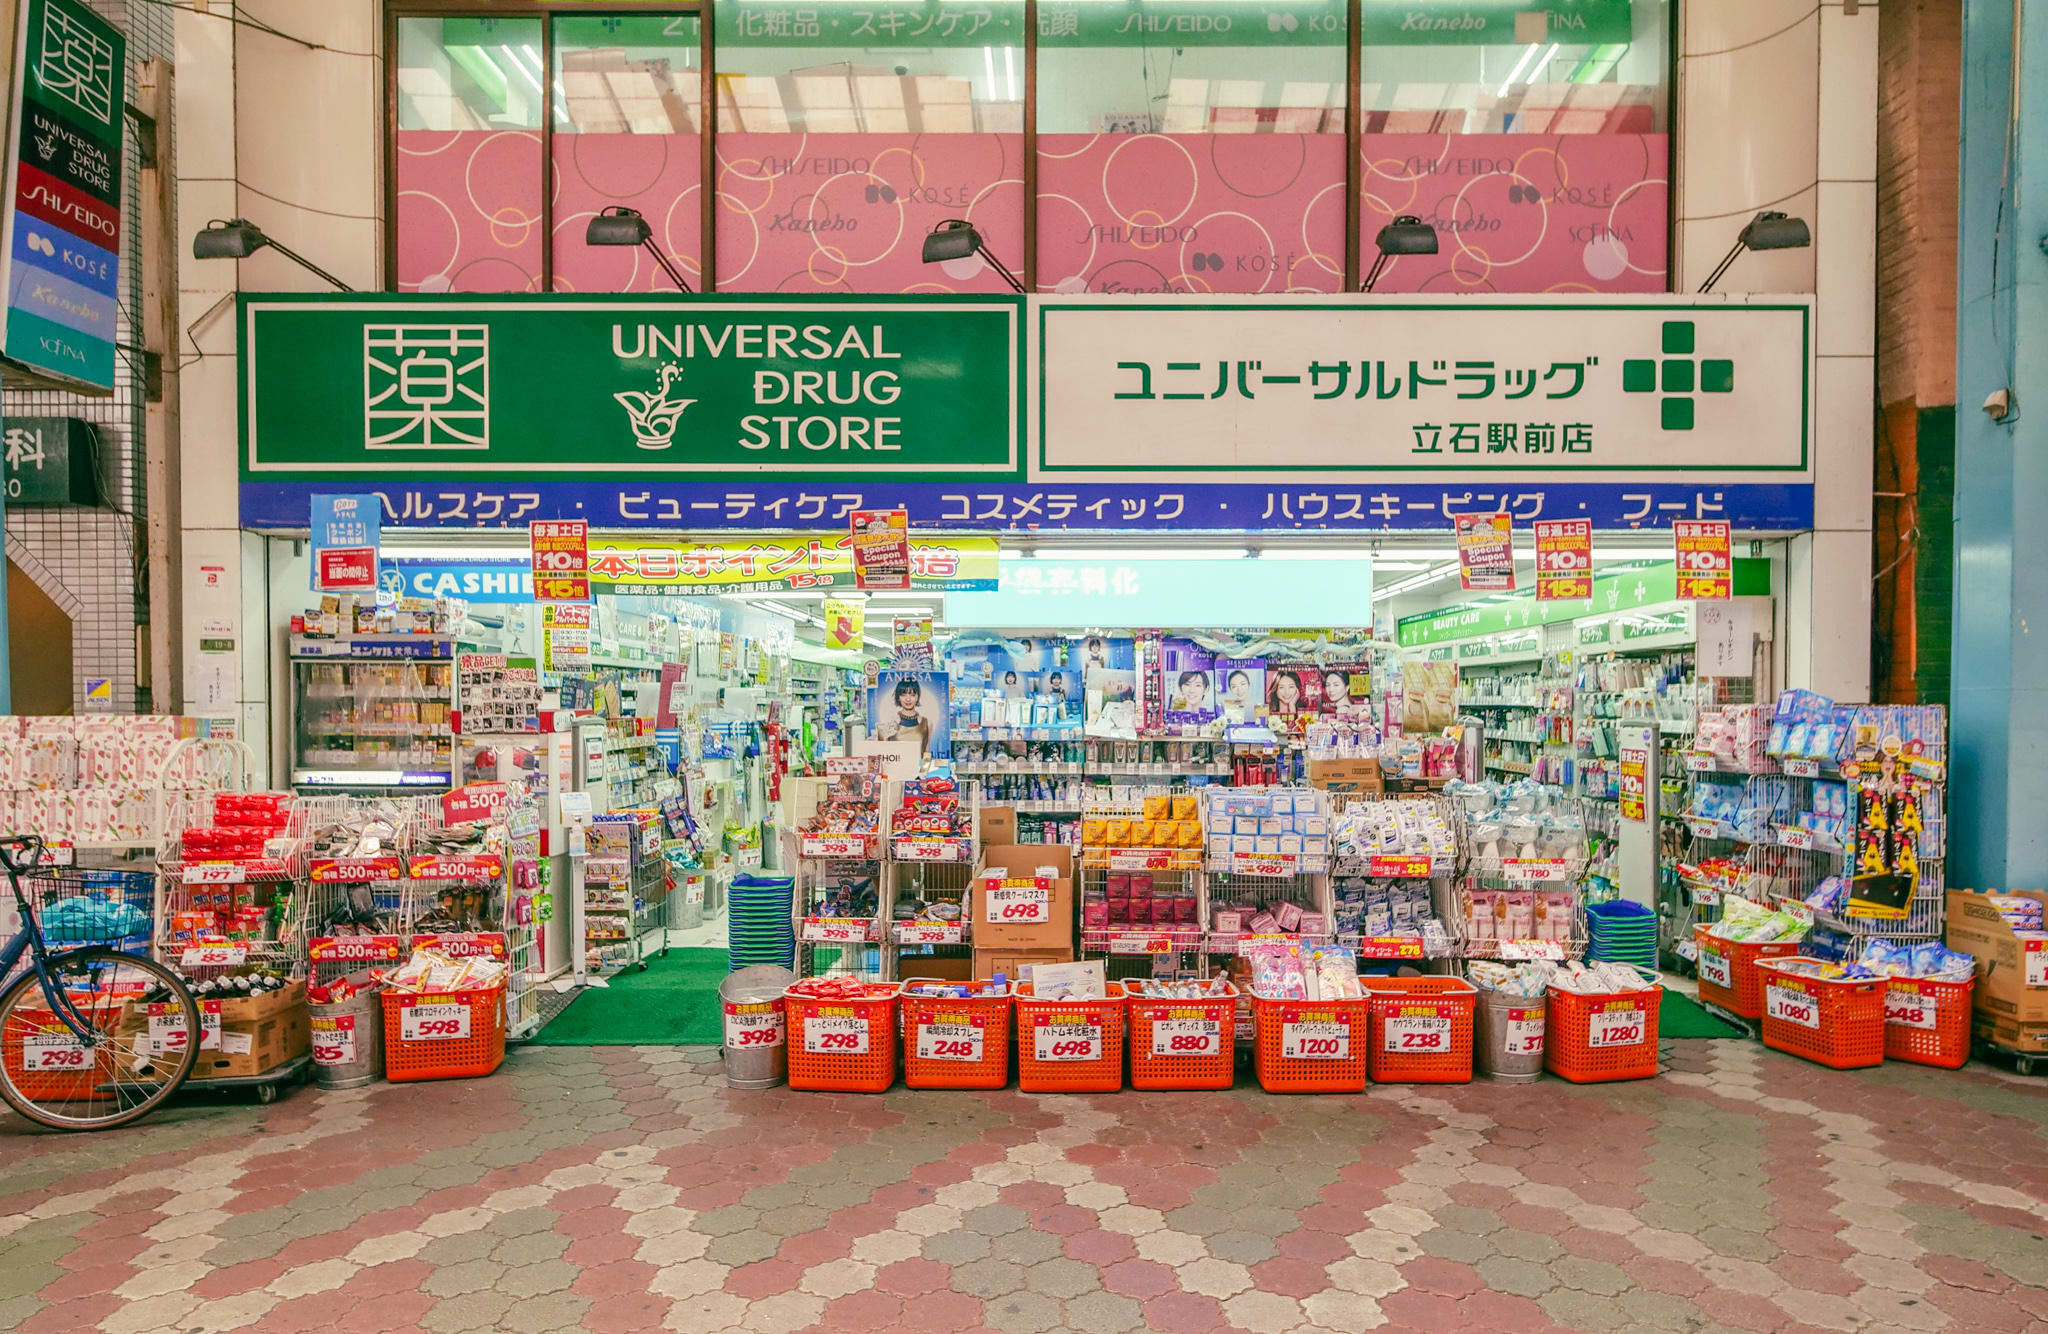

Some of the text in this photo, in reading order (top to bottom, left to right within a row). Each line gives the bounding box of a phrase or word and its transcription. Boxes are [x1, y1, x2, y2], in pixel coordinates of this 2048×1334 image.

[1115, 12, 1487, 33] SHISEIDO Kanebo
[34, 114, 110, 166] UNIVERSAL
[73, 149, 110, 178] DRUG
[756, 156, 870, 176] SHISEIDO
[1401, 156, 1515, 176] SHISEIDO
[69, 161, 110, 192] STORE
[22, 186, 115, 236] SHISEIDO
[769, 212, 858, 233] Kanebo
[1076, 226, 1198, 246] SHISEIDO
[1569, 223, 1634, 245] SOFINA
[32, 285, 100, 324] Kanebo
[40, 335, 85, 364] SOFINA
[612, 324, 902, 360] UNIVERSAL
[1114, 356, 1599, 400] ユニバーサルドラッグ
[738, 416, 902, 451] STORE
[1411, 422, 1594, 454] 立石駅前店
[372, 491, 1724, 520] ヘルスケア ビューティケア コスメティック ハウスキーピング フード
[534, 524, 583, 537] 毎週土日
[1537, 523, 1587, 536] 毎週土日
[1677, 524, 1727, 537] 毎週土日
[862, 543, 899, 555] Special
[863, 551, 901, 562] Coupon
[1467, 544, 1504, 556] Special
[1469, 551, 1506, 563] Coupon
[413, 571, 534, 595] CASHIE
[785, 574, 835, 589] 15倍
[1433, 612, 1480, 631] BEAUTY CARE
[1045, 639, 1076, 647] ANESSA
[885, 672, 932, 682] ANESSA
[822, 843, 848, 853] 398
[915, 848, 941, 857] 398
[202, 871, 231, 880] 197
[1256, 864, 1284, 874] 980
[1406, 863, 1428, 874] 258
[1522, 868, 1550, 878] 1780
[994, 890, 1045, 900] 新感覚クールマスク
[1002, 904, 1039, 918] 698
[823, 929, 849, 939] 398
[918, 932, 945, 941] 398
[200, 953, 228, 962] 85
[1399, 945, 1421, 956] 278
[1705, 965, 1725, 982] 798
[1778, 1002, 1811, 1022] 1080
[1884, 1005, 1924, 1023] 648
[418, 1020, 460, 1036] 598
[926, 1026, 979, 1037] 瞬間冷却スプレー
[1042, 1027, 1098, 1037] ハトムギ化粧水
[1602, 1025, 1640, 1042] 1280
[738, 1028, 777, 1045] 398
[820, 1033, 859, 1049] 298
[1170, 1035, 1209, 1051] 880
[1401, 1033, 1441, 1048] 238
[933, 1040, 973, 1056] 248
[1051, 1041, 1091, 1056] 698
[1299, 1038, 1339, 1054] 1200
[41, 1050, 84, 1067] 298
